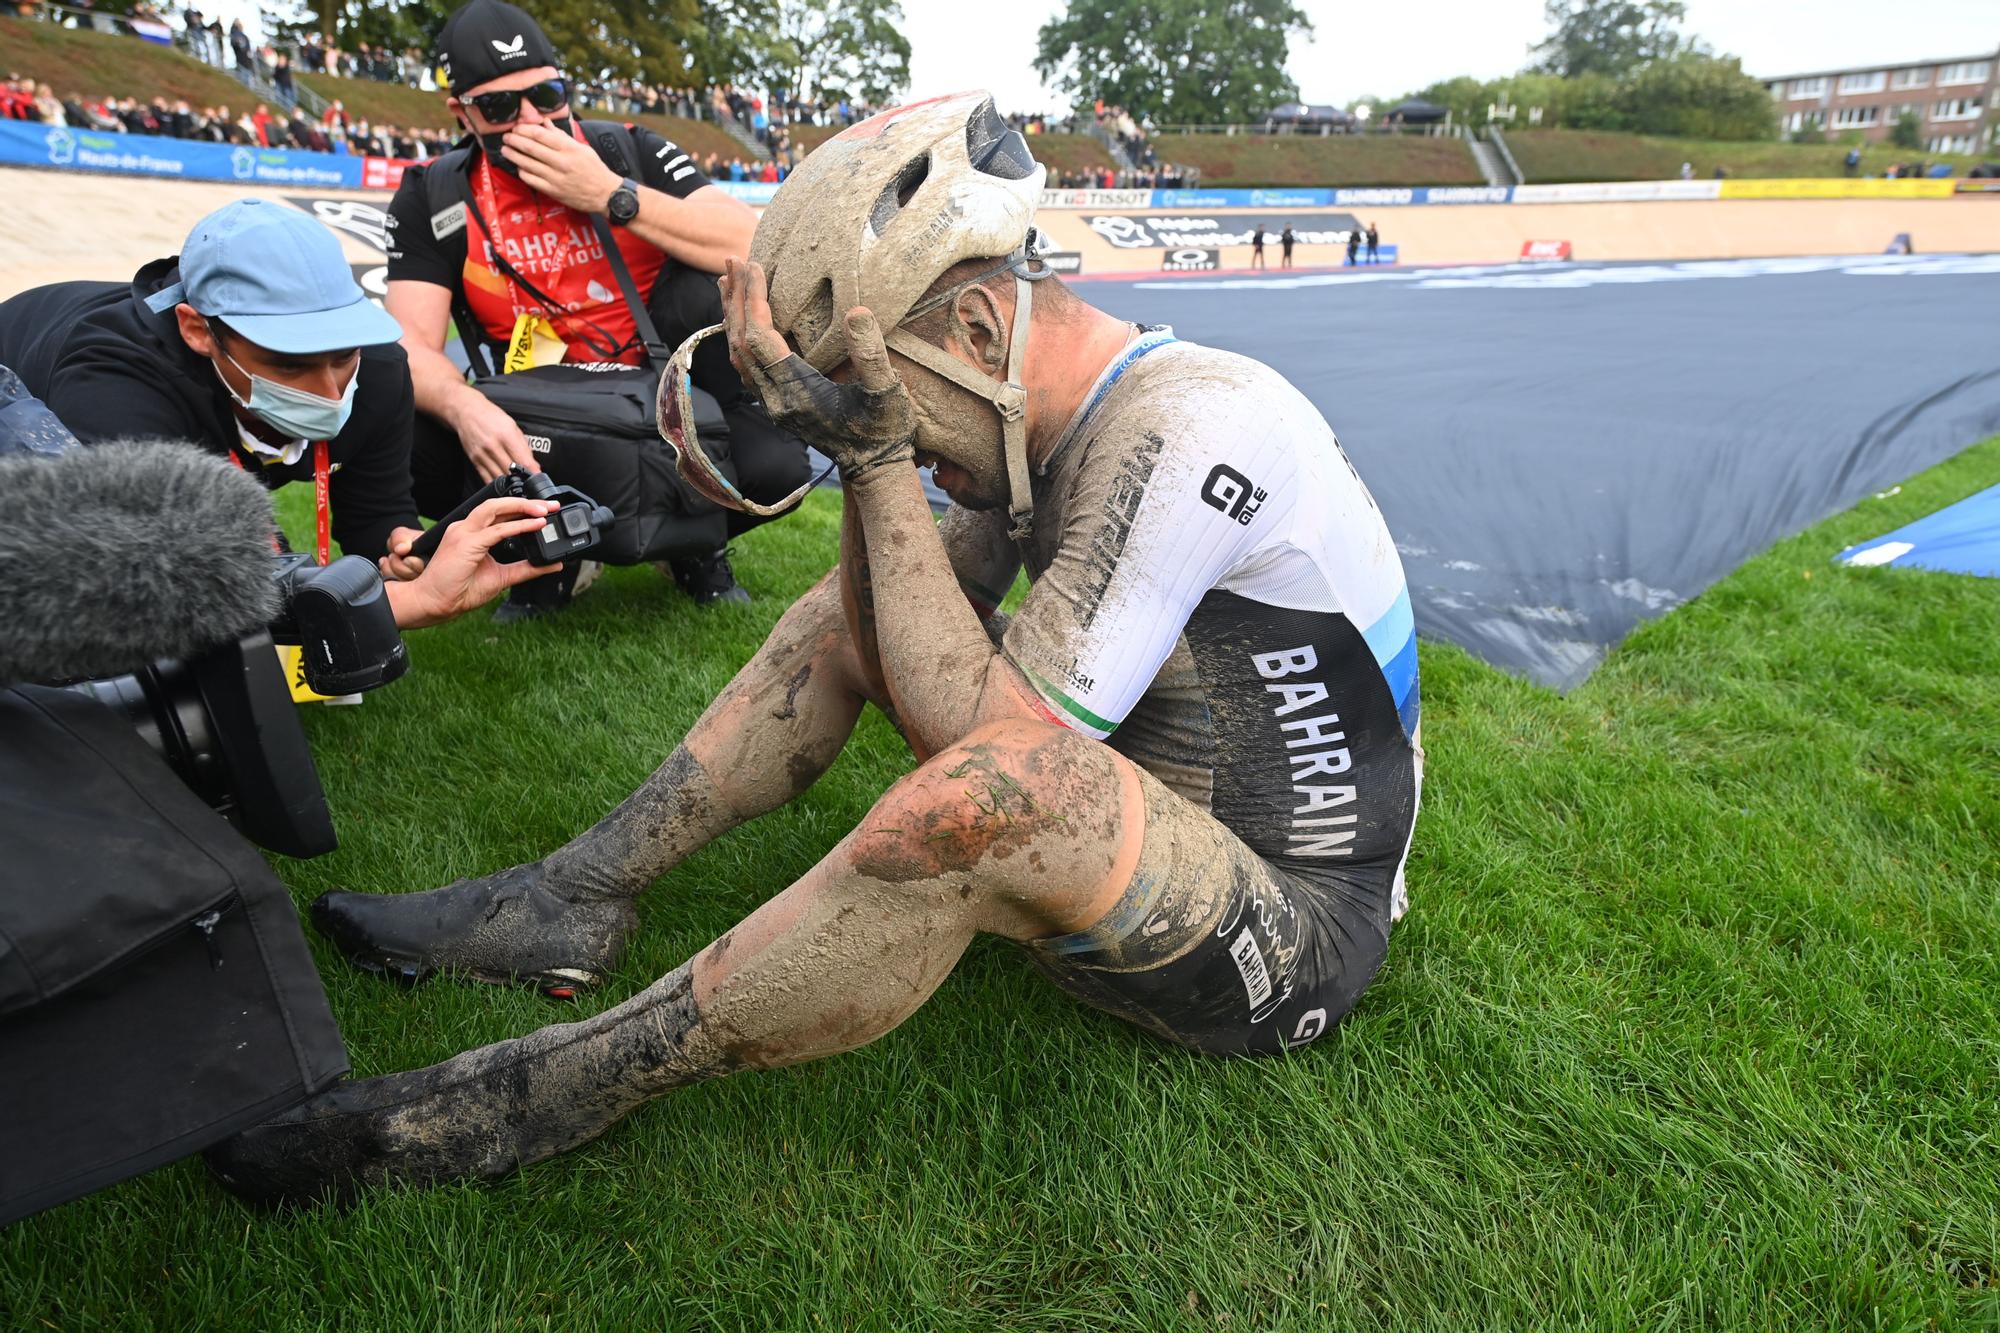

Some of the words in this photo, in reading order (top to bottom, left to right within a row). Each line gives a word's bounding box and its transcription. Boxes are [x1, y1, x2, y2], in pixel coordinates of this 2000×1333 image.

[78, 149, 183, 173] Hauts-de-France
[256, 165, 343, 184] Hauts-de-France
[1090, 192, 1147, 204] TISSOT
[1335, 188, 1412, 205] SHIMANO
[1427, 186, 1507, 204] SHIMANO
[1251, 644, 1357, 857] BAHRAIN
[1238, 941, 1268, 1002] BAHRAIN
